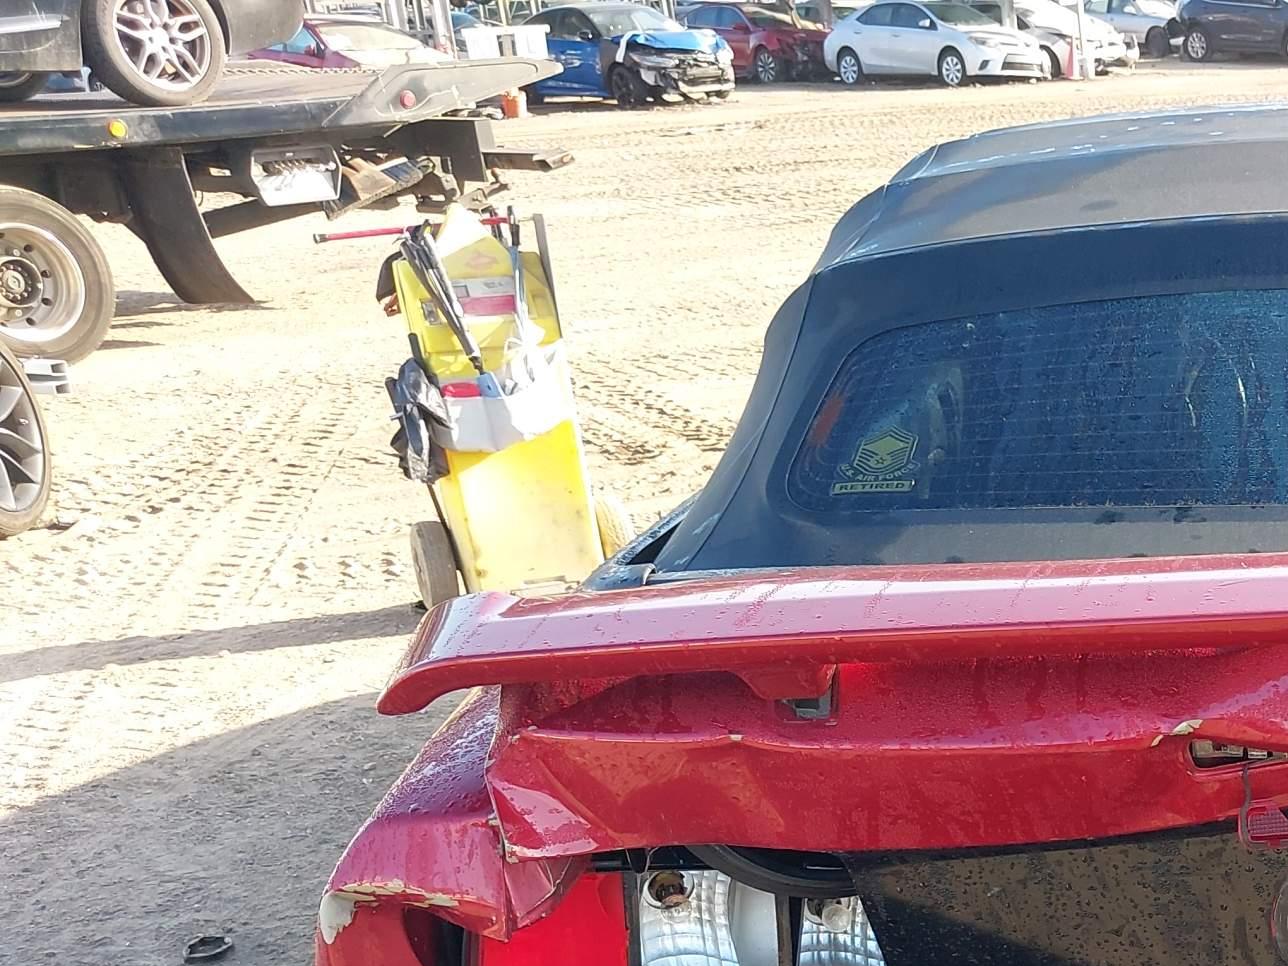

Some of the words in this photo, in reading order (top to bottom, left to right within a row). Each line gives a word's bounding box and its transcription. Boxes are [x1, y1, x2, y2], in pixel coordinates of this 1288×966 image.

[854, 474, 875, 482] AIR
[878, 463, 916, 481] FORCE
[838, 482, 905, 491] RETIRED
